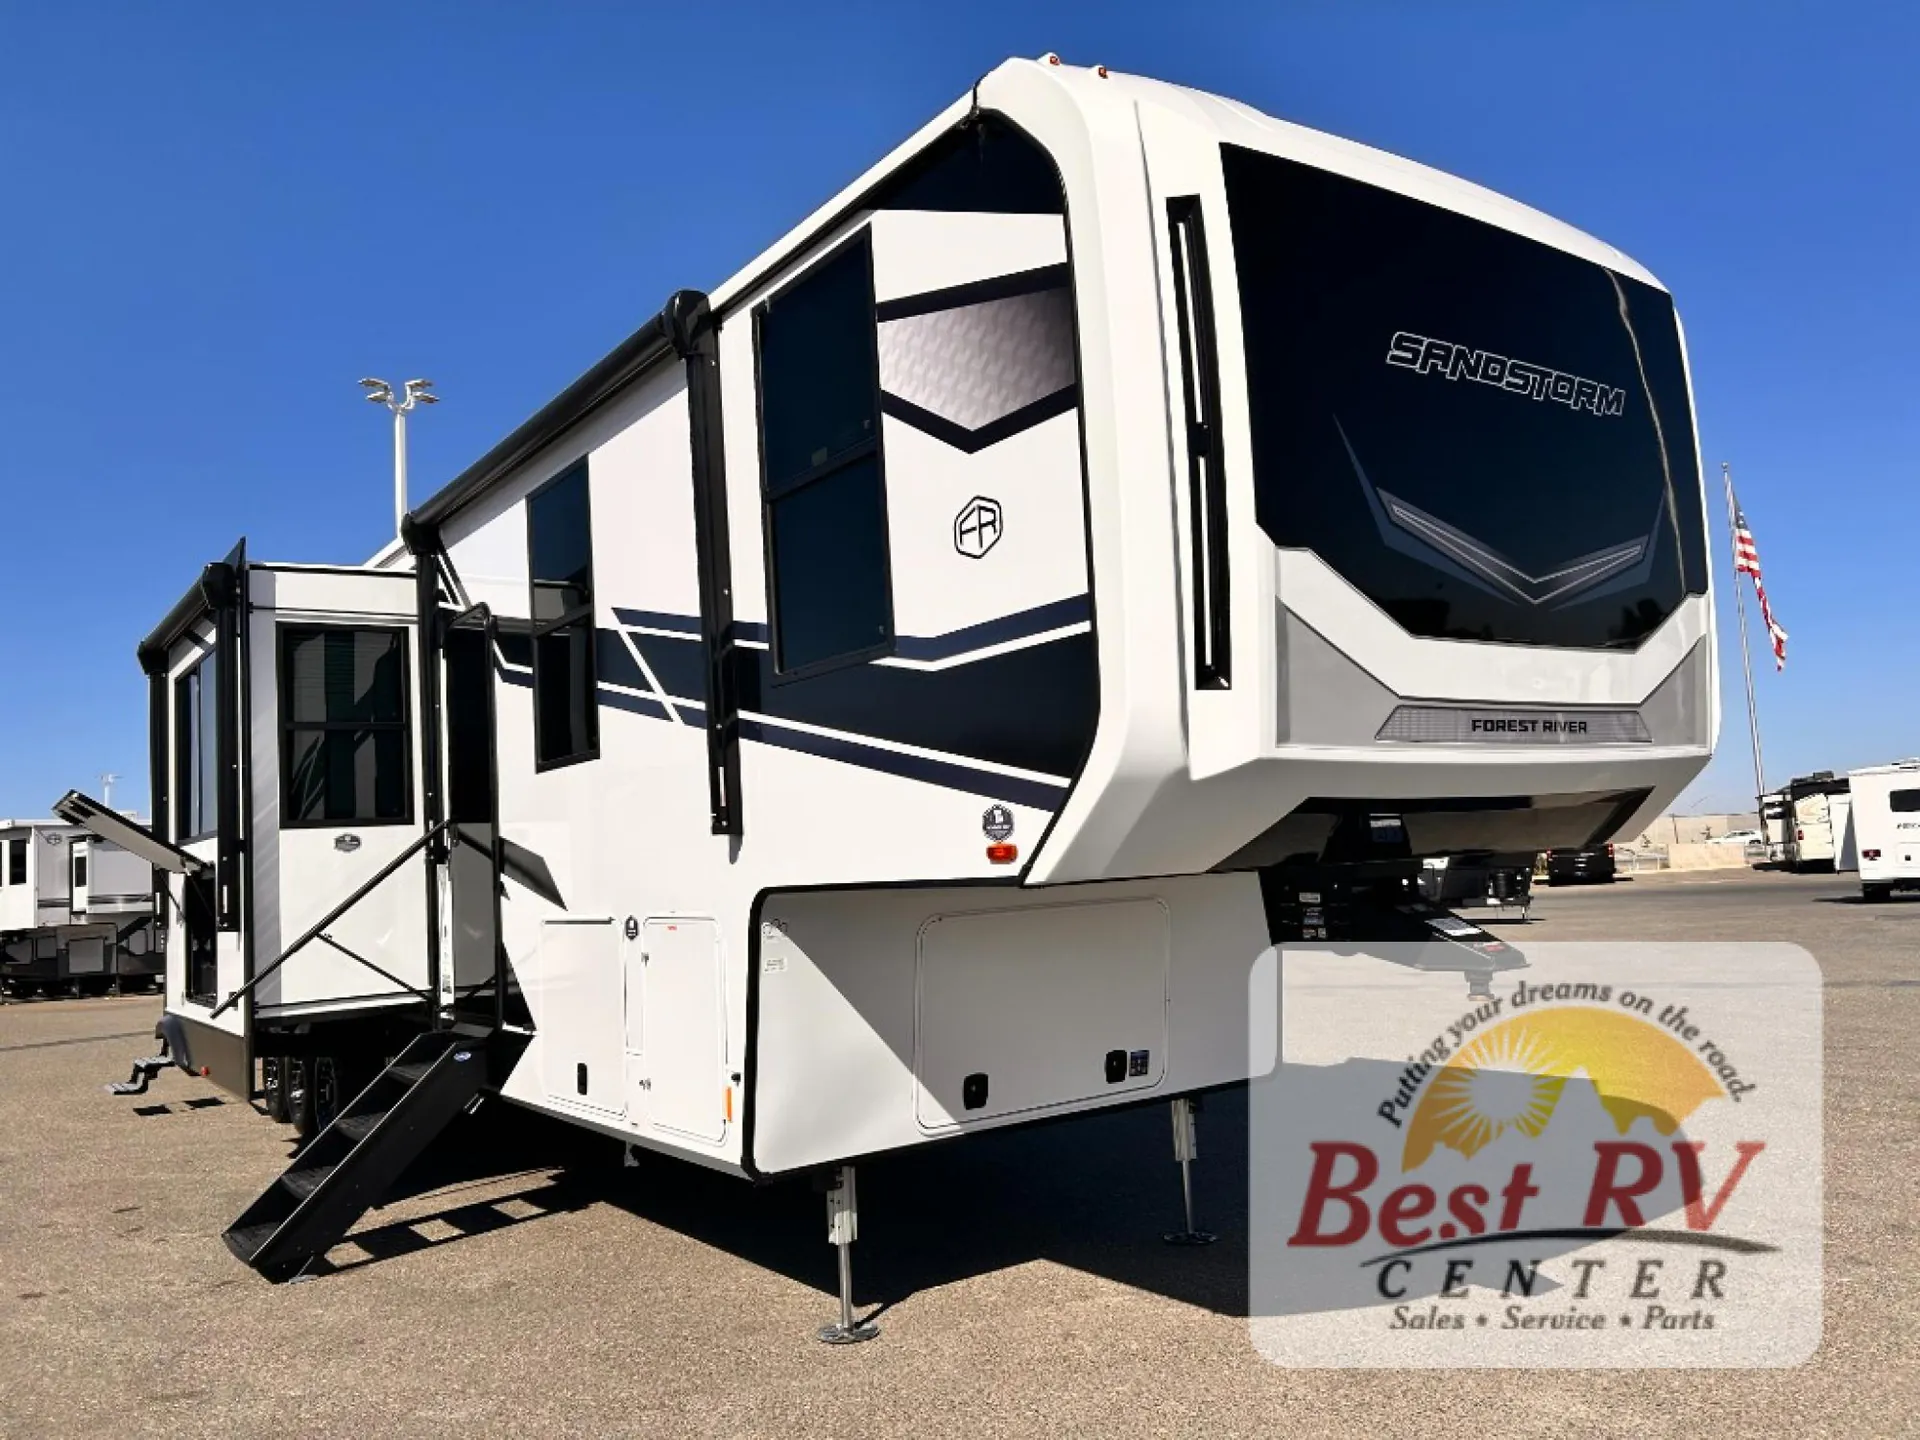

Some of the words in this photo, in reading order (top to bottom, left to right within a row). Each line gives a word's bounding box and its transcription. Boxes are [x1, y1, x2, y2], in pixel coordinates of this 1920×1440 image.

[1386, 331, 1625, 416] SANDSTORM
[1471, 719, 1538, 732] FOREST
[1542, 720, 1587, 733] RIVER
